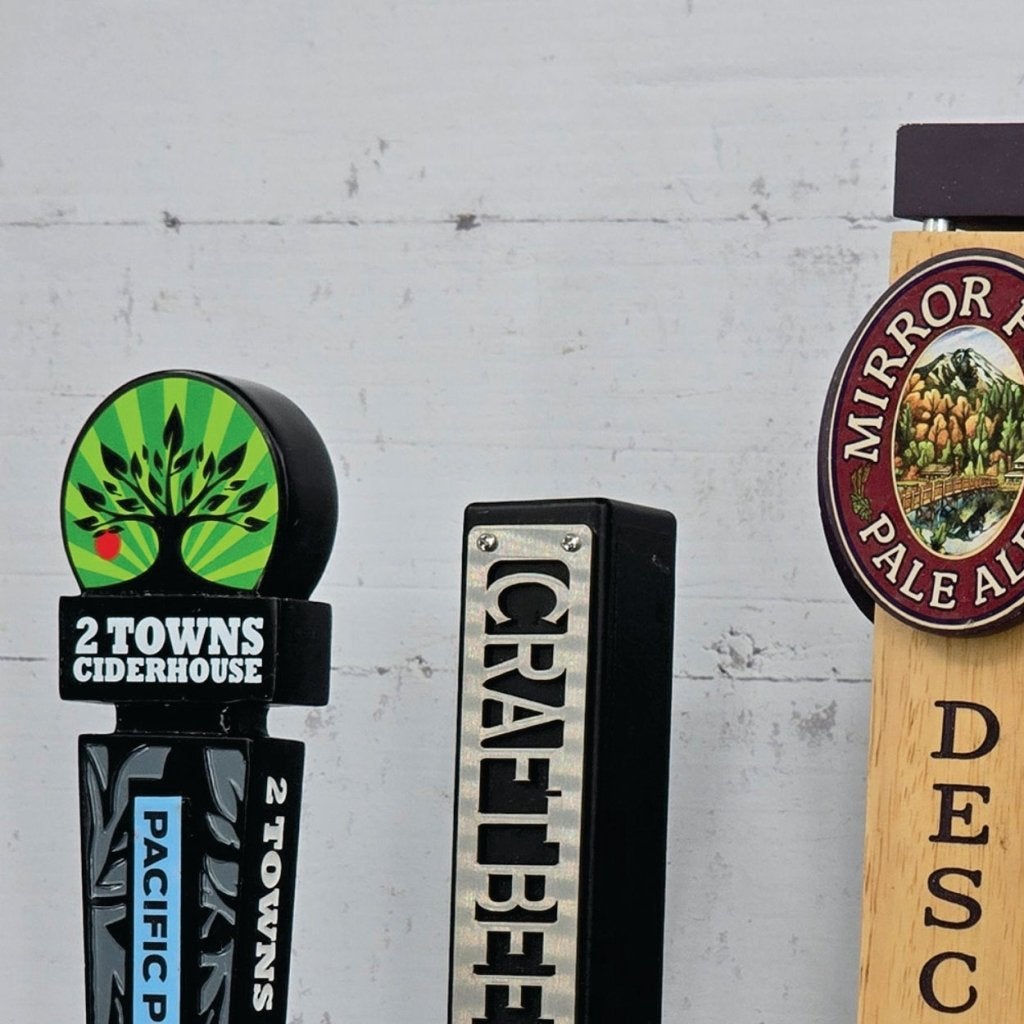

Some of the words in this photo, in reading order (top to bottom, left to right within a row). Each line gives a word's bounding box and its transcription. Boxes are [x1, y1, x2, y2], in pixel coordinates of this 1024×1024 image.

[844, 276, 993, 463] MIRROR
[859, 513, 957, 610] PALE
[72, 656, 263, 684] CIDERHOUSE
[75, 616, 99, 654] 2
[107, 616, 264, 656] TOWNS
[266, 776, 288, 804] 2
[142, 811, 168, 983] PACIFIC
[253, 816, 285, 1011] TOWNS
